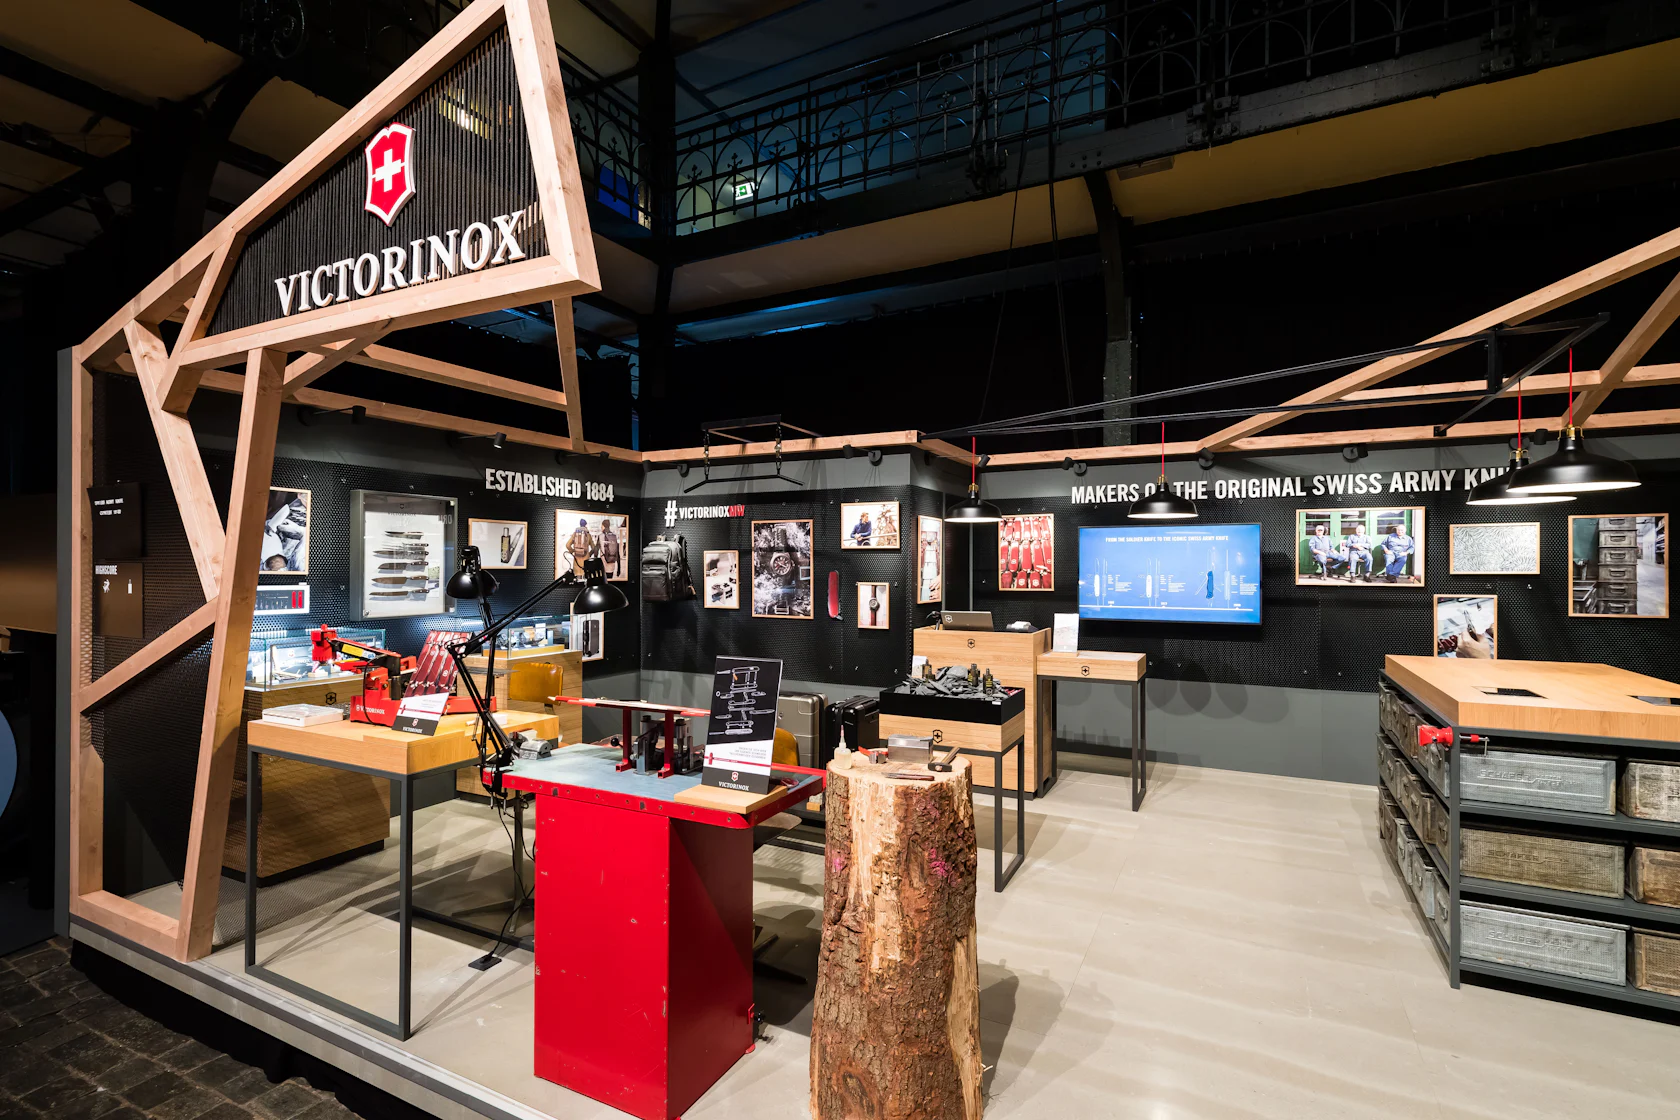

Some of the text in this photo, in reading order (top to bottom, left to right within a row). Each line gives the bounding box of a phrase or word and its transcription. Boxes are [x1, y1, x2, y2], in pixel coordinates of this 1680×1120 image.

[274, 209, 526, 316] VICTORINOX
[485, 468, 614, 502] ESTABLISHED 1884
[1071, 483, 1139, 504] MAKERS
[1173, 481, 1208, 500] THE
[1215, 476, 1307, 500] ORIGINAL
[1312, 473, 1382, 495] SWISS
[1389, 469, 1456, 493] ARMY
[718, 781, 750, 791] VICTORINOX
